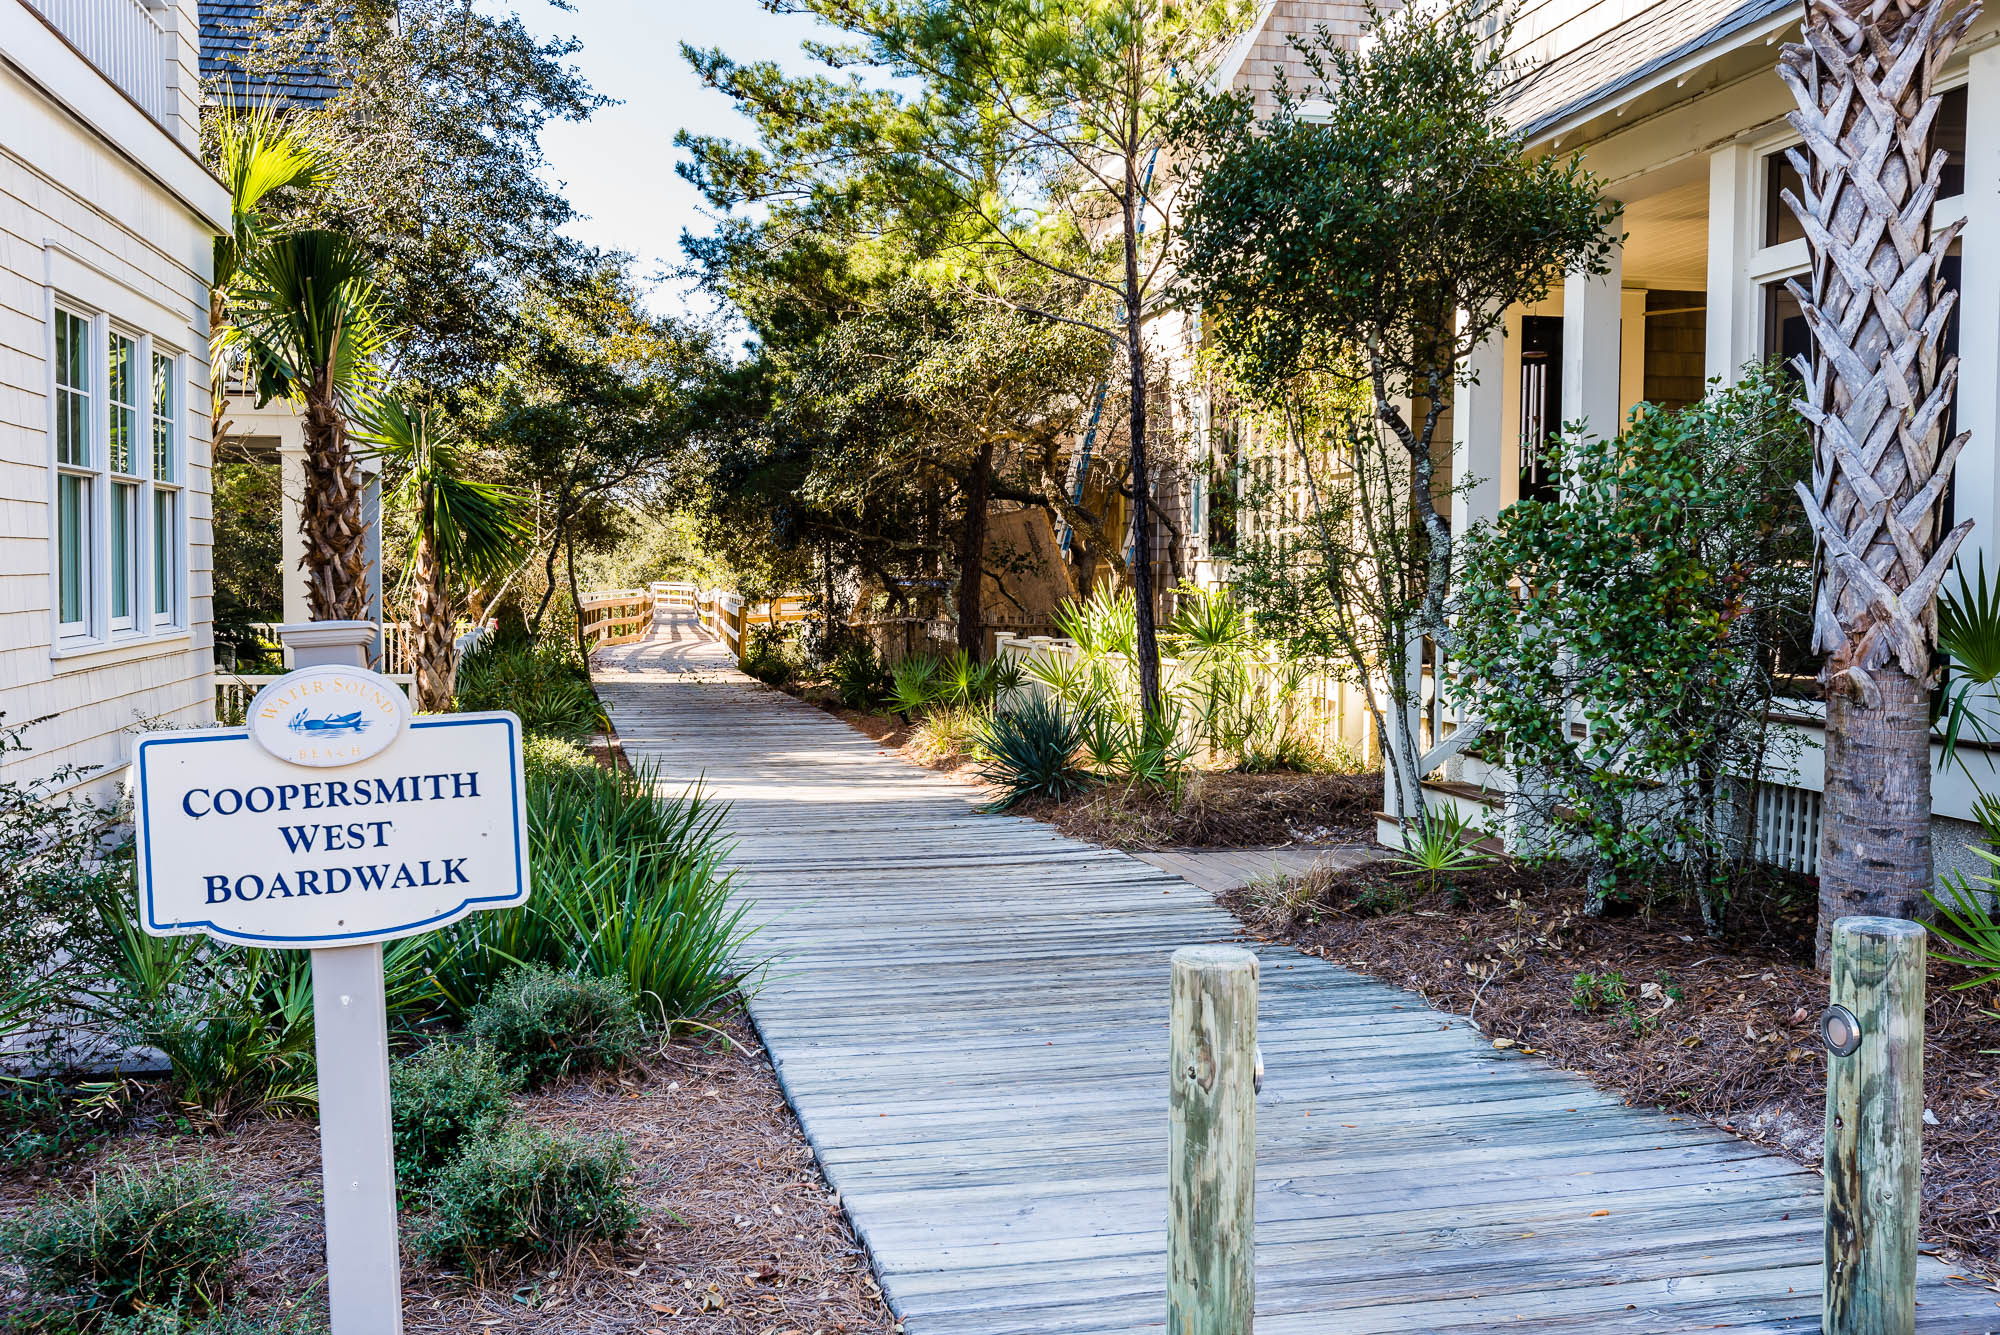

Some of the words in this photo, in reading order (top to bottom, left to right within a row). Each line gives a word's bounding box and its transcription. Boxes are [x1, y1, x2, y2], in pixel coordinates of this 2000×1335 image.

[298, 745, 362, 761] BEACH
[182, 772, 481, 818] COOPERSMITH
[278, 821, 393, 854] WEST
[203, 857, 470, 904] BOARDWALK
